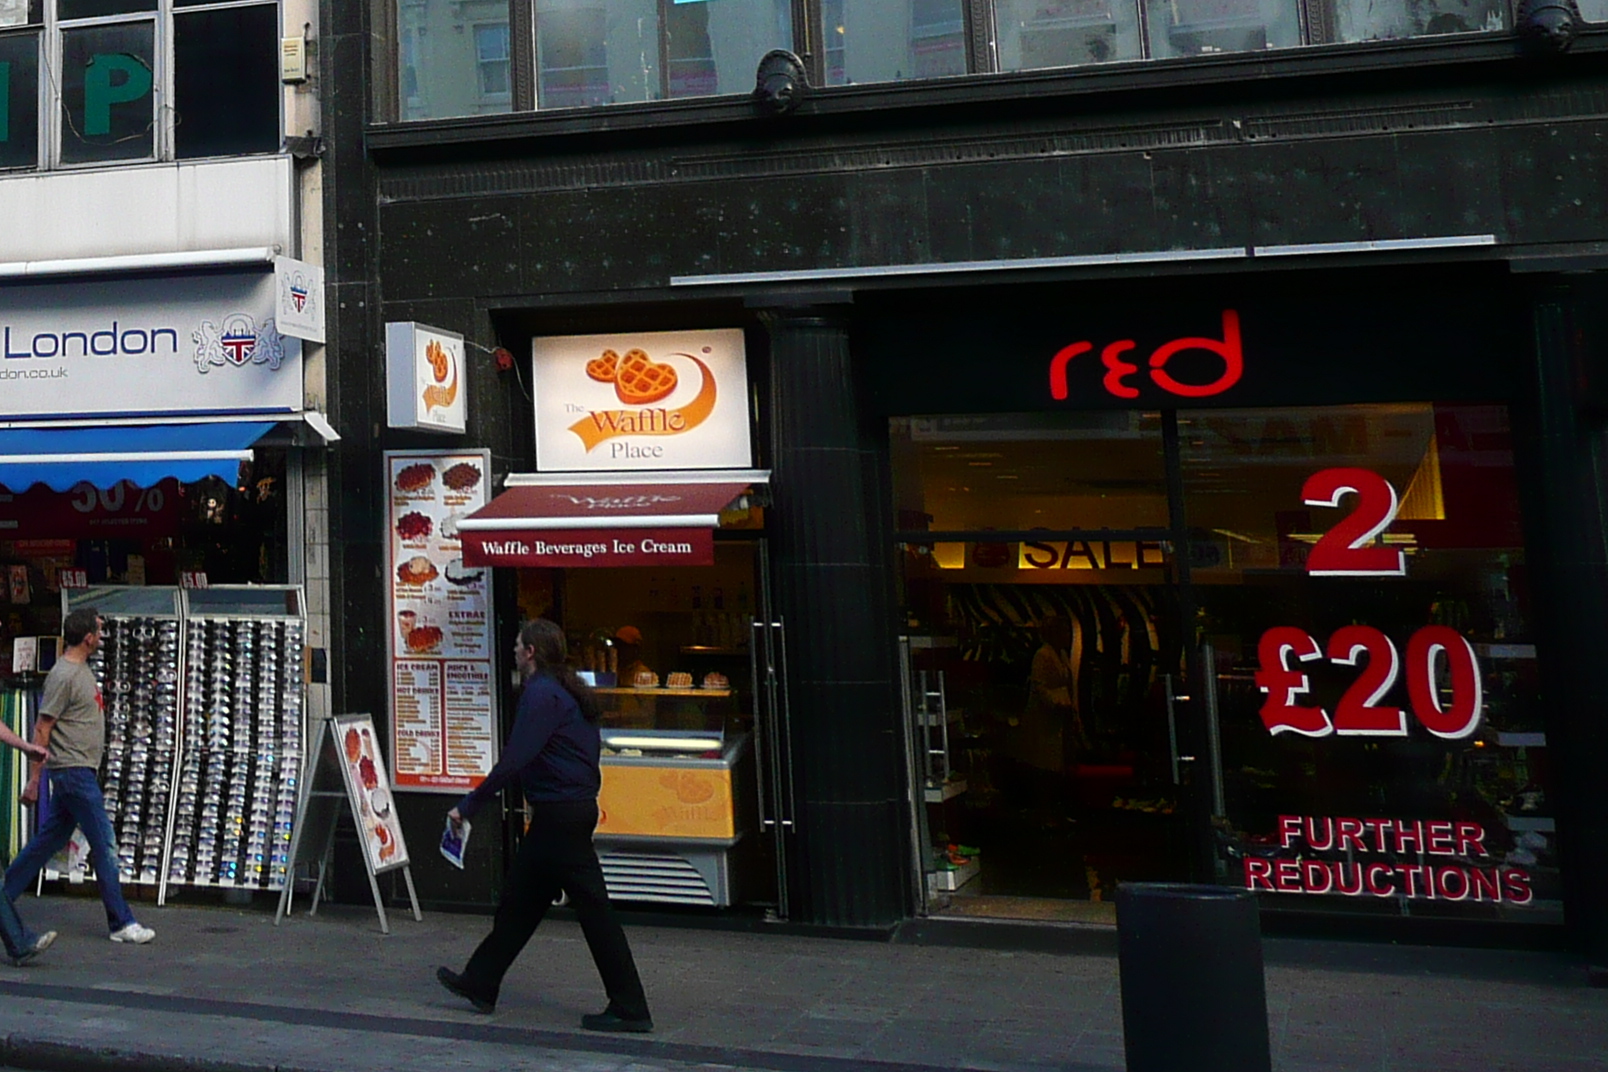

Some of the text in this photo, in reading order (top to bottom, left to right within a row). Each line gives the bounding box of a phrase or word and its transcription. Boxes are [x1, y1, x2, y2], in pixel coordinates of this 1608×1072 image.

[3, 321, 178, 359] London
[1049, 309, 1243, 400] red
[564, 403, 584, 414] The
[588, 408, 686, 434] Waffle
[610, 441, 663, 459] Place
[1301, 468, 1406, 576] 2
[482, 539, 692, 558] Waffle Beverages Ice Cream
[1024, 527, 1170, 569] SALE
[1255, 625, 1484, 740] £20
[1278, 815, 1490, 857] FURTHER
[1243, 858, 1534, 905] REDUCTIONS
